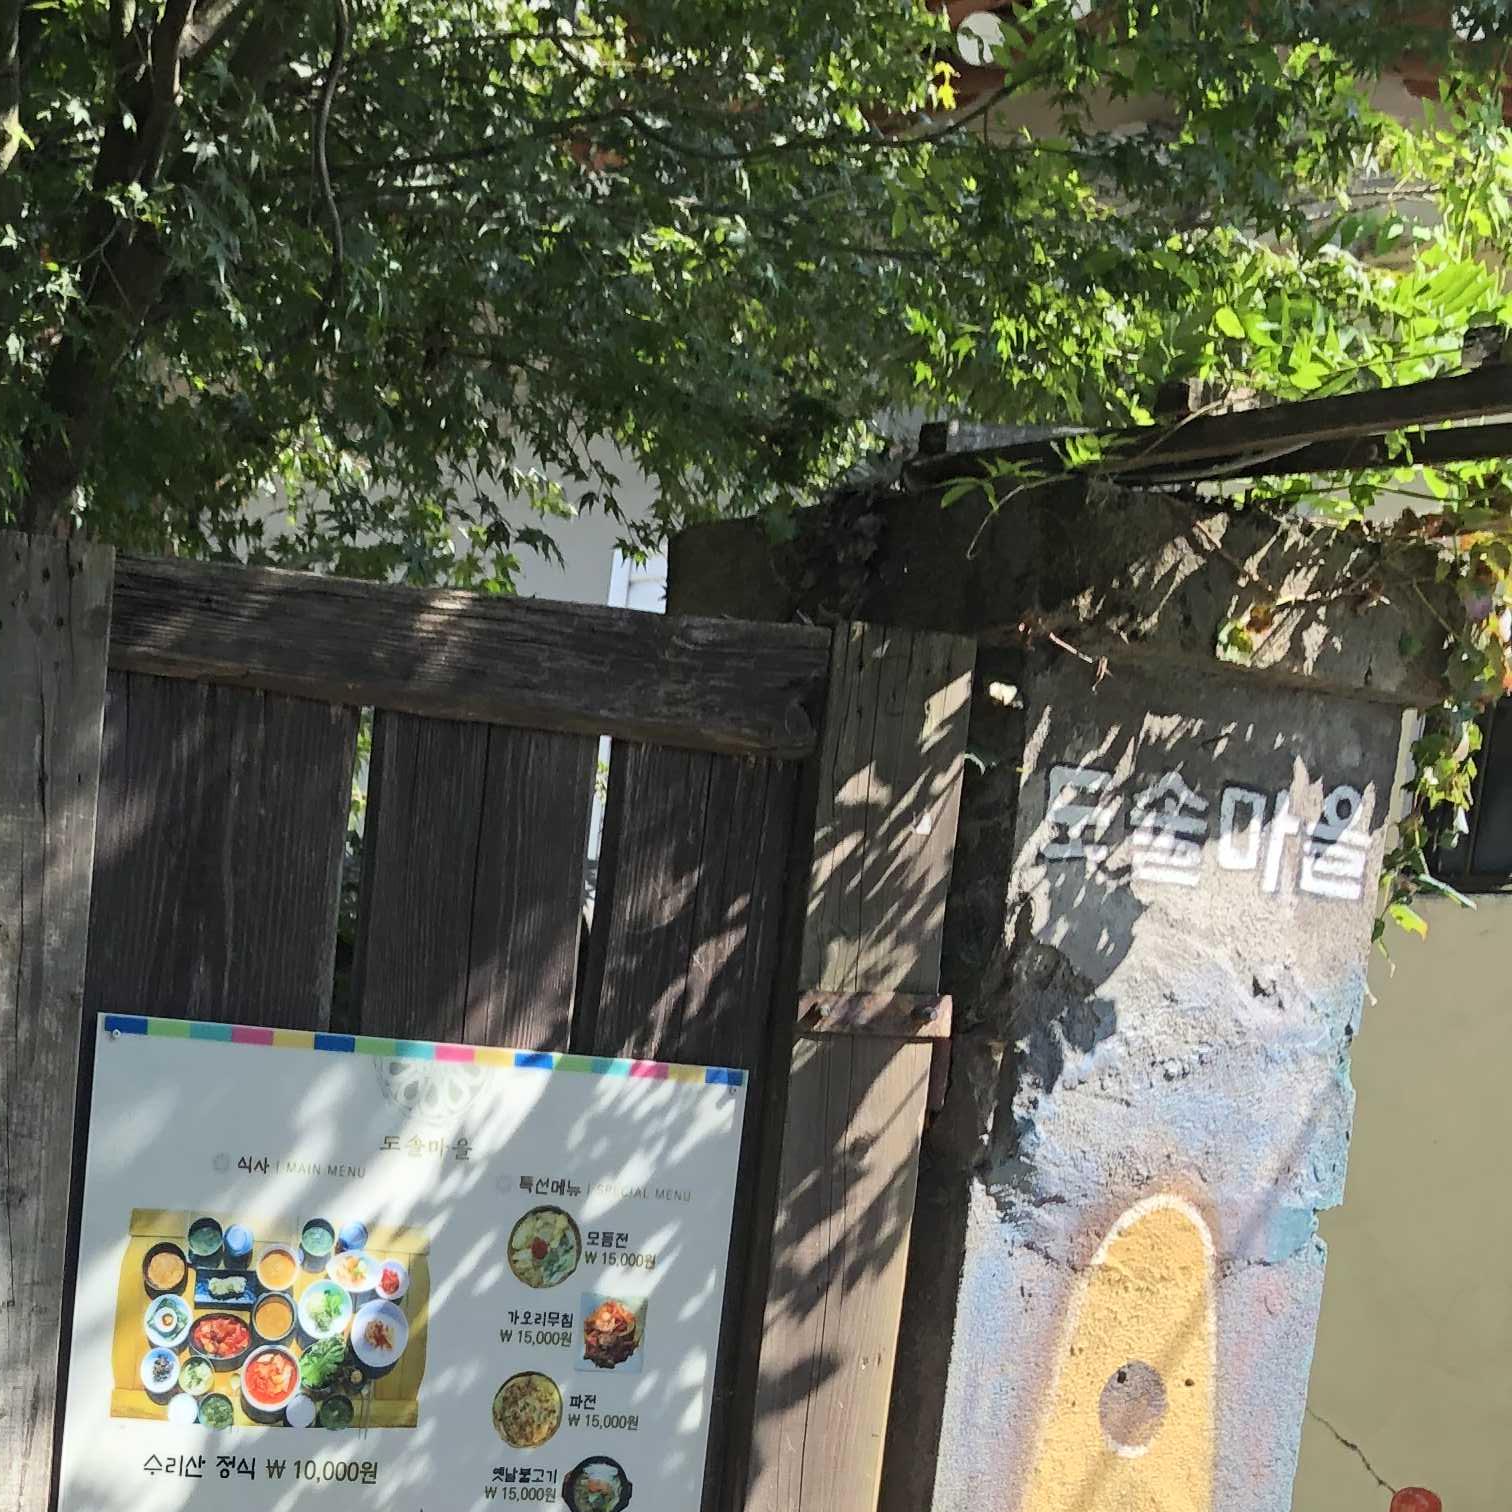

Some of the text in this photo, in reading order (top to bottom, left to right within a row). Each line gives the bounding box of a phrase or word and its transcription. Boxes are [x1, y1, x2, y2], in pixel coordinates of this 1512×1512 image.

[1038, 763, 1374, 900] 도솔마을
[379, 1134, 473, 1161] 도솔마을
[237, 1155, 366, 1178] 식사 MAIN MENU
[519, 1175, 581, 1196] 특선메뉴
[654, 1187, 693, 1201] MENU
[586, 1231, 629, 1249] 모듬전
[602, 1252, 656, 1270] 15,000원
[507, 1310, 573, 1328] 가오리무침
[518, 1329, 572, 1347] 15,000원
[569, 1395, 596, 1410] 파전
[585, 1414, 639, 1431] 15,000원
[143, 1454, 205, 1478] 수리산
[216, 1455, 256, 1480] 정식
[293, 1459, 378, 1484] 10,000원
[492, 1467, 558, 1484] 옛날불고기
[502, 1487, 557, 1503] 15,000원
